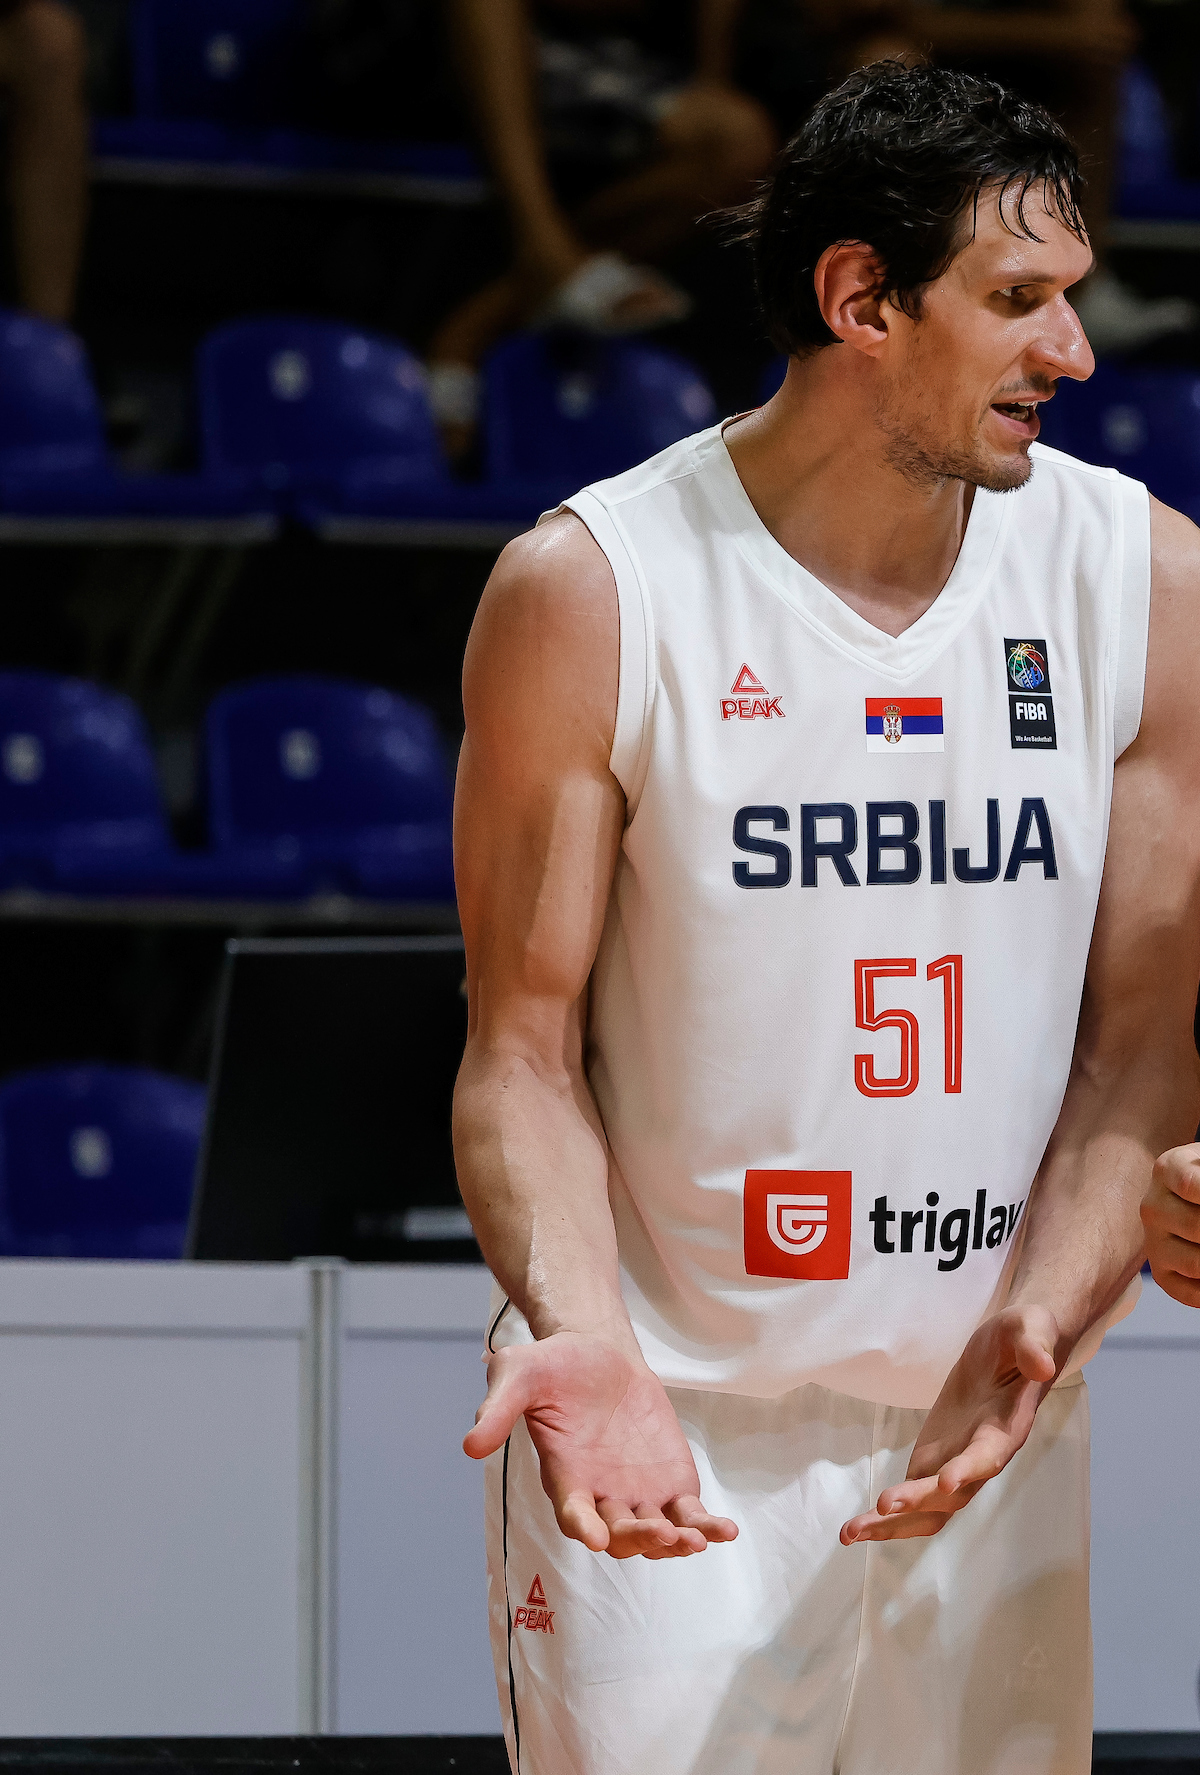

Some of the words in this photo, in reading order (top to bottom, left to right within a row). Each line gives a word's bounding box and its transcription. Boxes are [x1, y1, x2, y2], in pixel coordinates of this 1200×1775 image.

[719, 695, 785, 721] PEAK
[1015, 702, 1047, 720] FIBA
[731, 797, 1059, 890] SRBIJA
[854, 954, 963, 1098] 51
[868, 1188, 1026, 1272] triglav
[513, 1606, 555, 1634] PEAK
